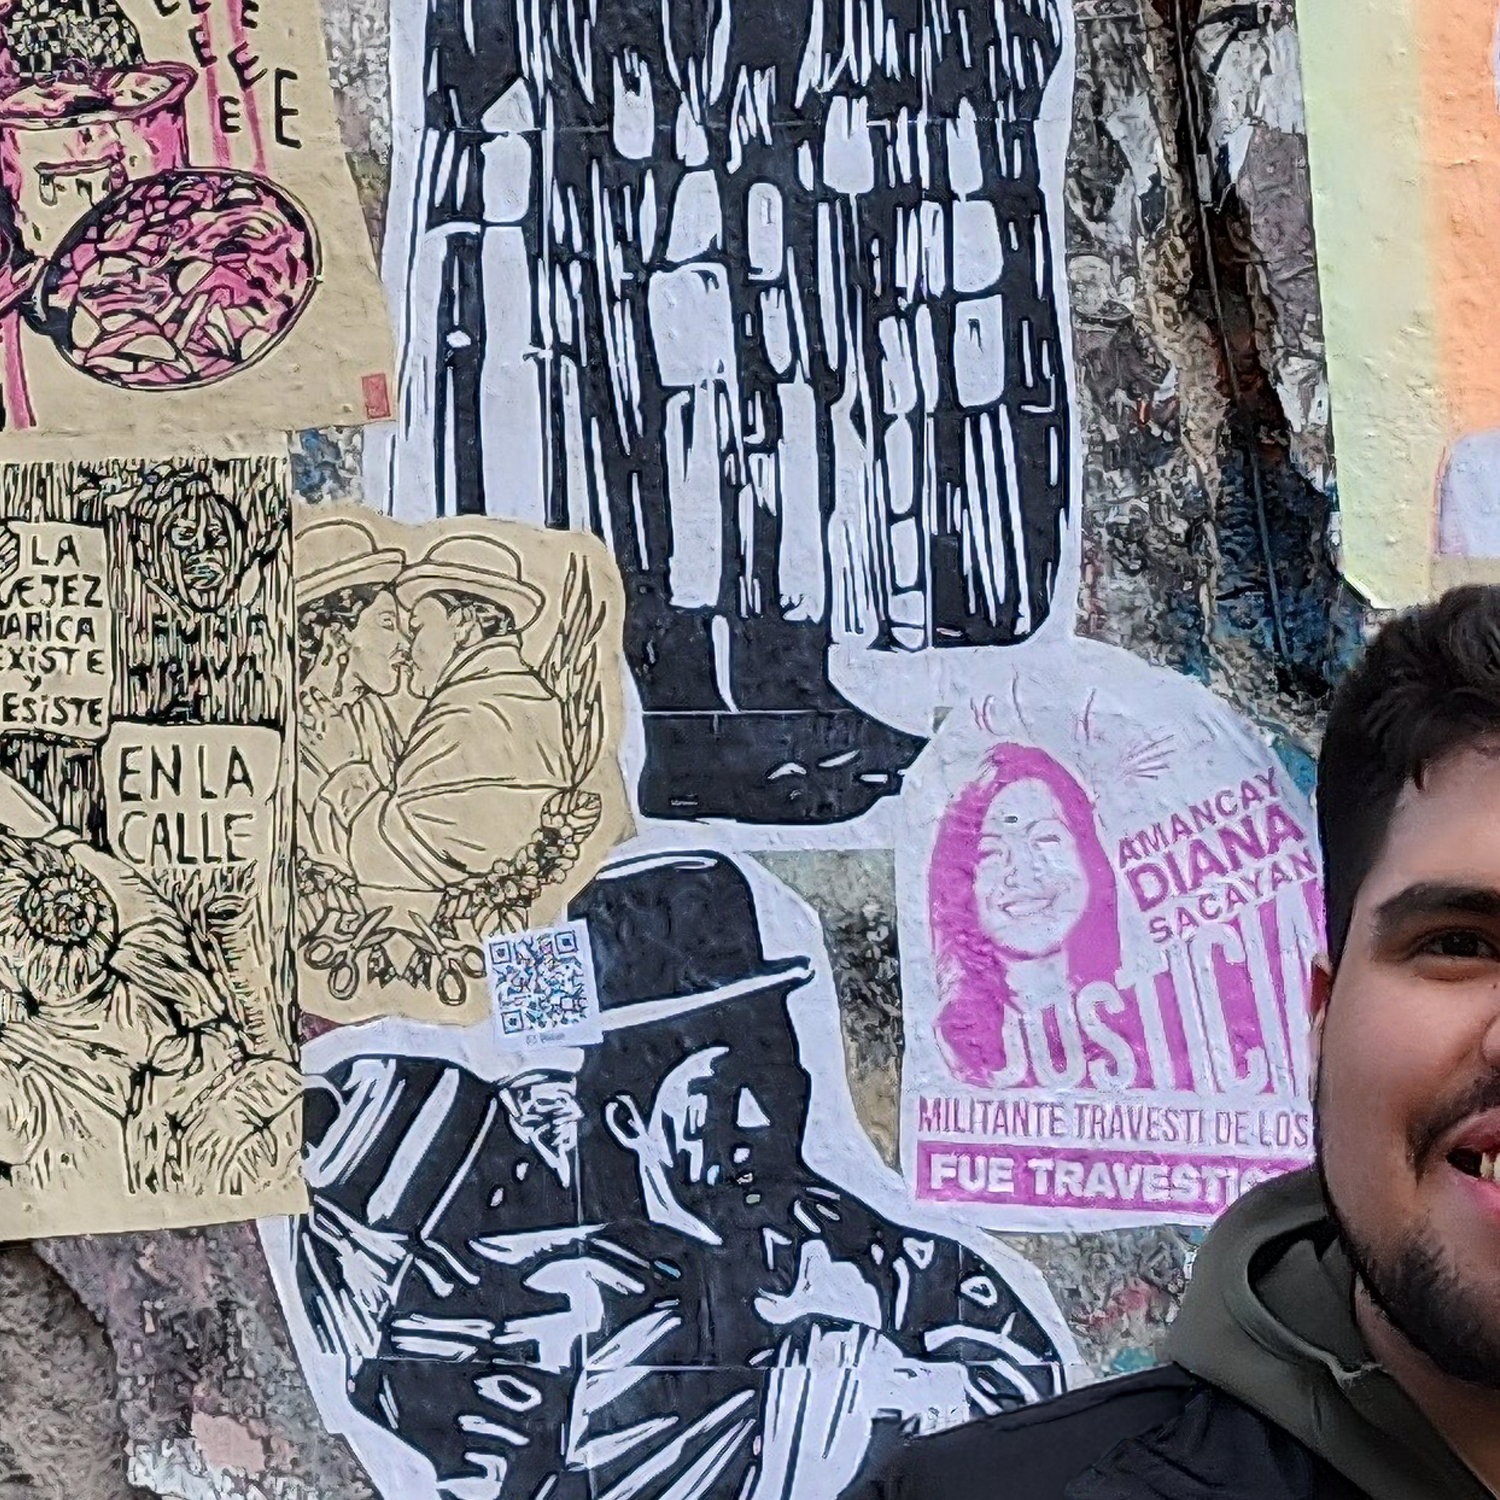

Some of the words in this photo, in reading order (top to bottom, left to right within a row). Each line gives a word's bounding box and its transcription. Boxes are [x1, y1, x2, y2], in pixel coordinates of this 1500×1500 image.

[31, 534, 81, 568] LA
[118, 744, 183, 803] EN
[198, 744, 255, 801] LA
[118, 810, 257, 866] CALLE
[1118, 766, 1281, 869] AMANCAY
[1125, 803, 1308, 913] DIANA
[1149, 848, 1319, 943] SACAYAN
[917, 1096, 1065, 1138] MILITANTE
[1073, 1102, 1203, 1147] TRAVESTI
[1215, 1110, 1250, 1146] DE
[1258, 1110, 1309, 1148] LOS
[929, 1152, 1015, 1196] FUE
